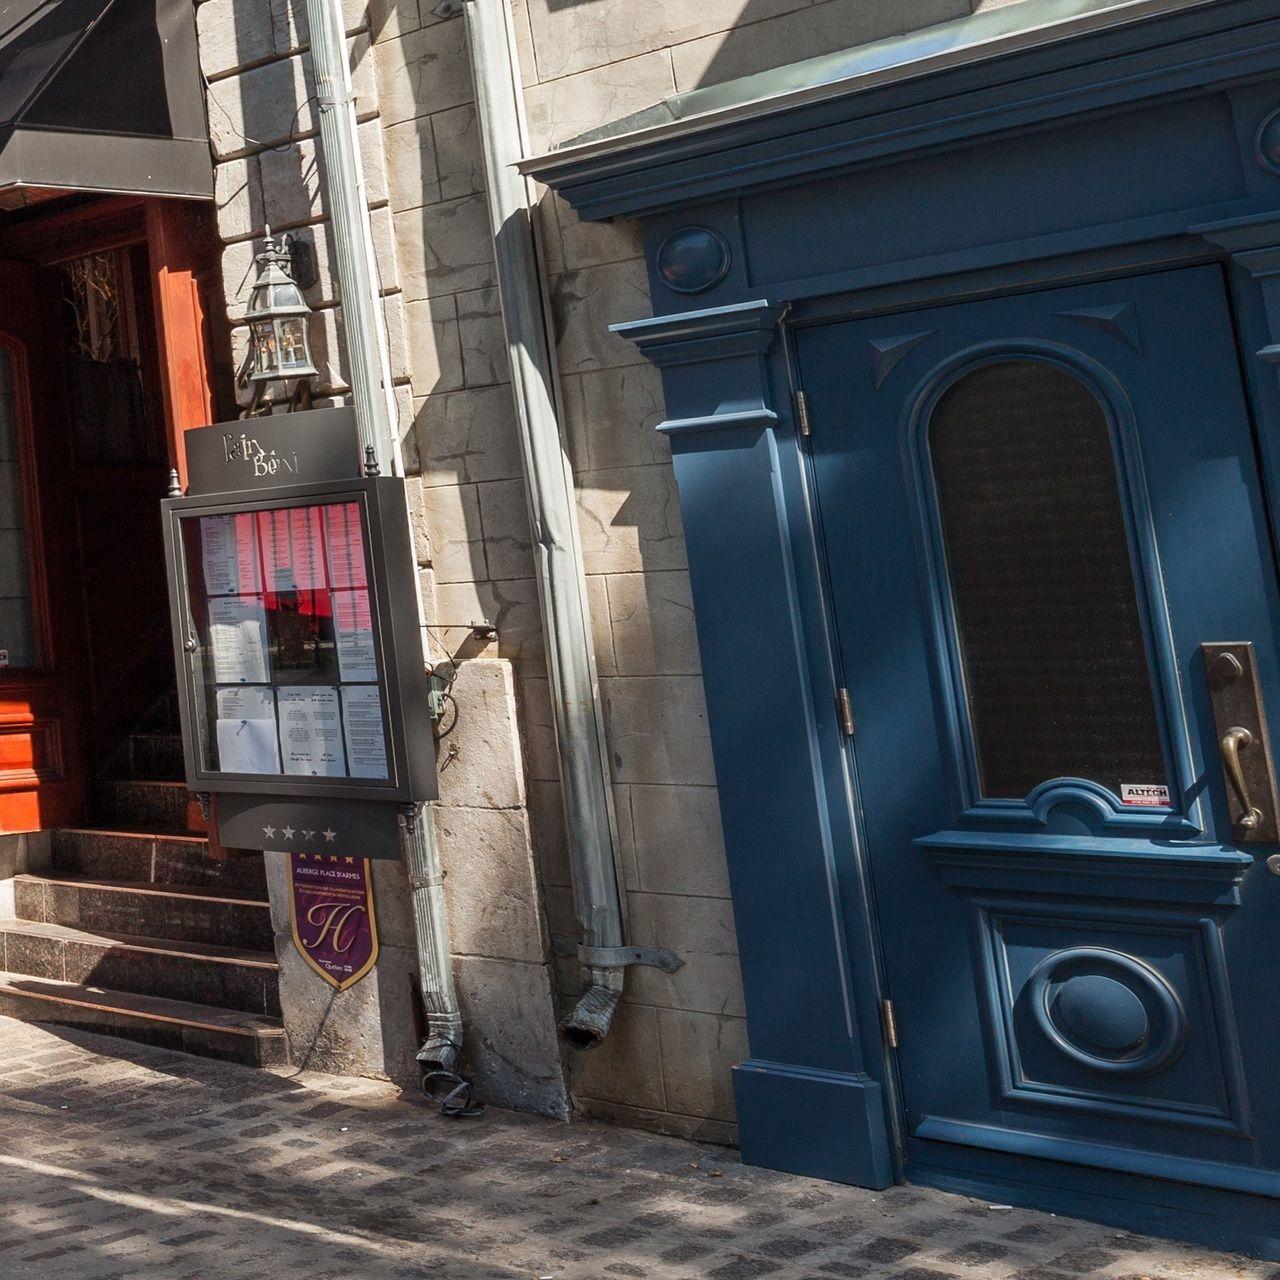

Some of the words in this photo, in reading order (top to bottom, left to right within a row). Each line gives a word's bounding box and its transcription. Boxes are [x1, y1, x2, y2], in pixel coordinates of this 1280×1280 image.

[222, 433, 266, 463] Pain
[253, 450, 301, 477] Béni
[1127, 788, 1168, 796] ALTECH
[296, 867, 320, 876] AUBERGE
[320, 869, 337, 878] PLACE
[336, 871, 360, 880] D'ARMES
